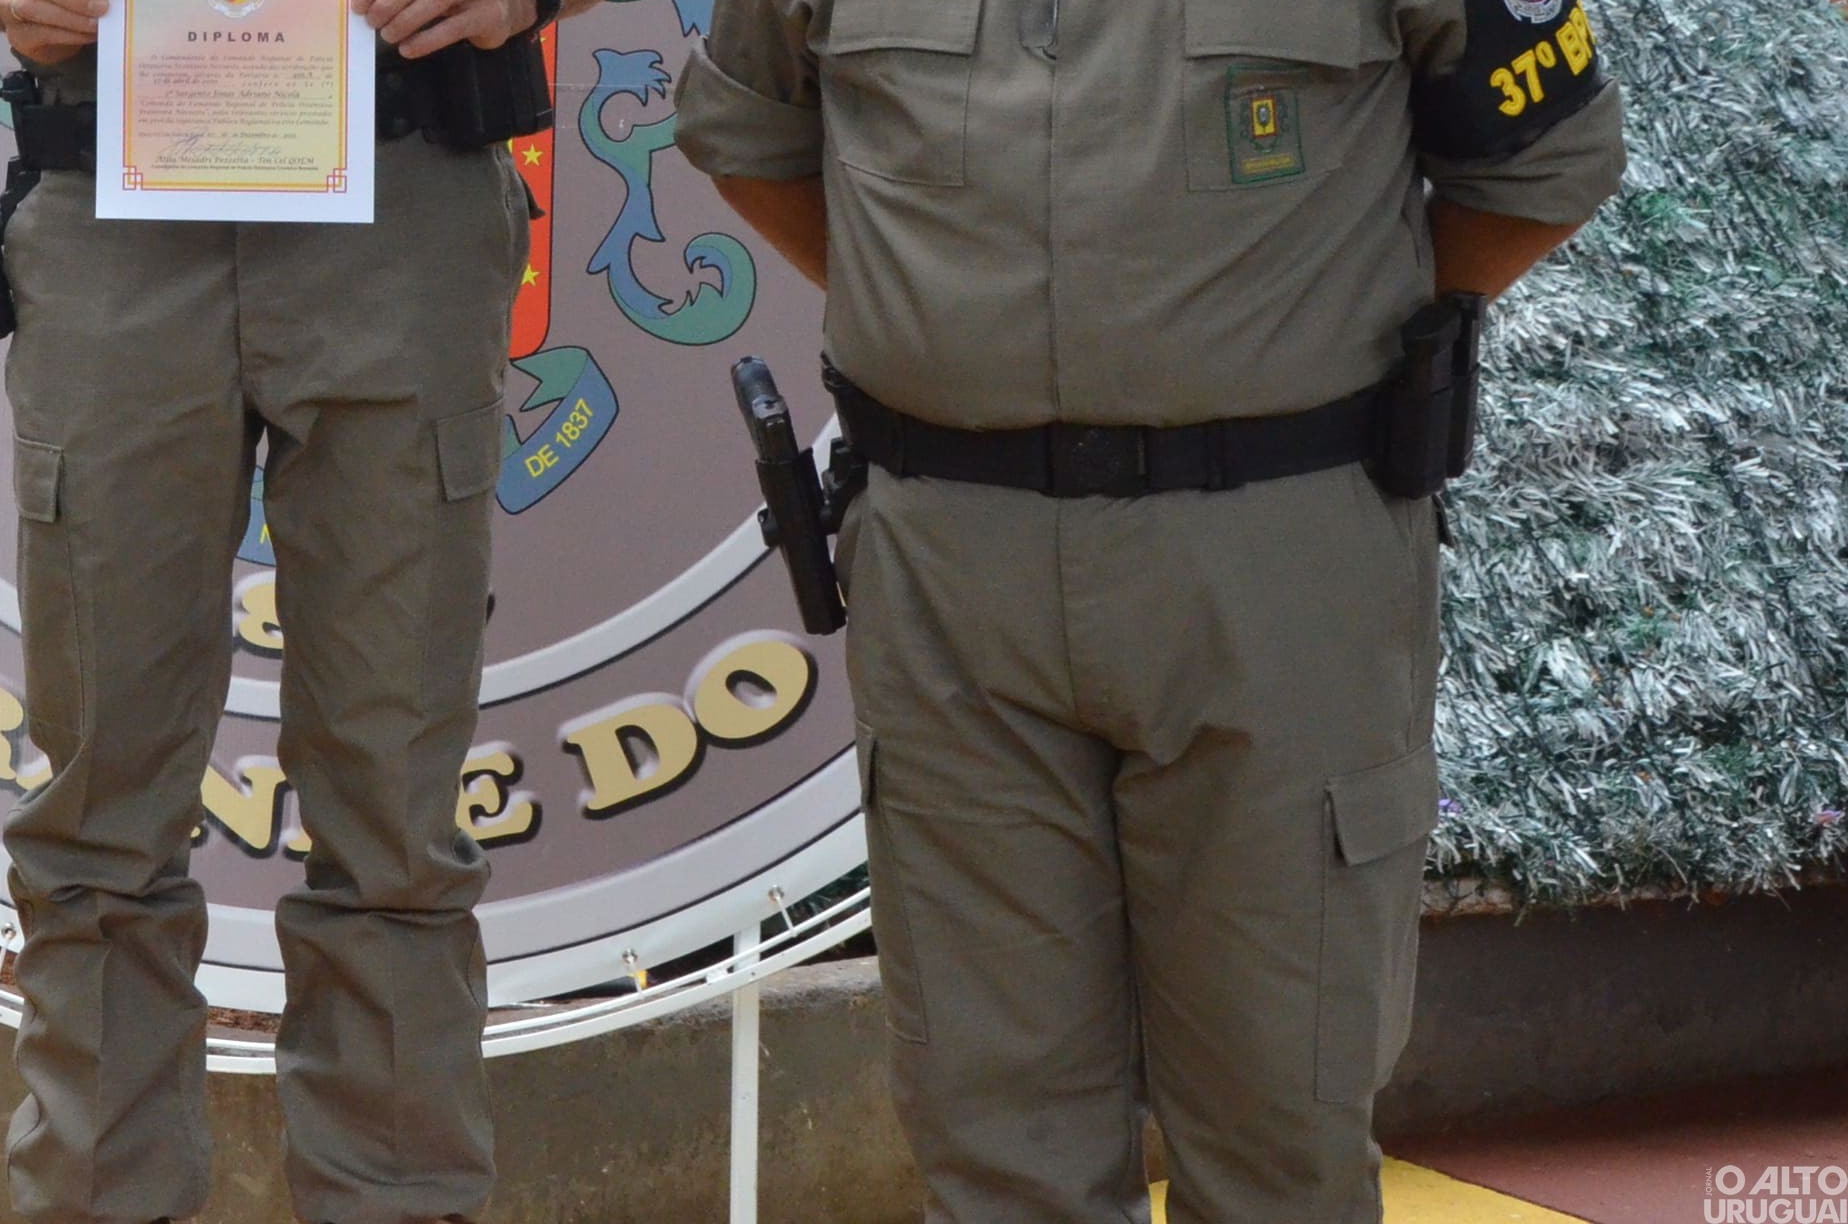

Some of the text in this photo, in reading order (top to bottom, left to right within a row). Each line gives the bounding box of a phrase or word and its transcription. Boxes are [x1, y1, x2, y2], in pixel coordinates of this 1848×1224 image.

[187, 31, 286, 43] DIPLOMA
[524, 397, 594, 478] DE 1837
[560, 631, 817, 816] DO
